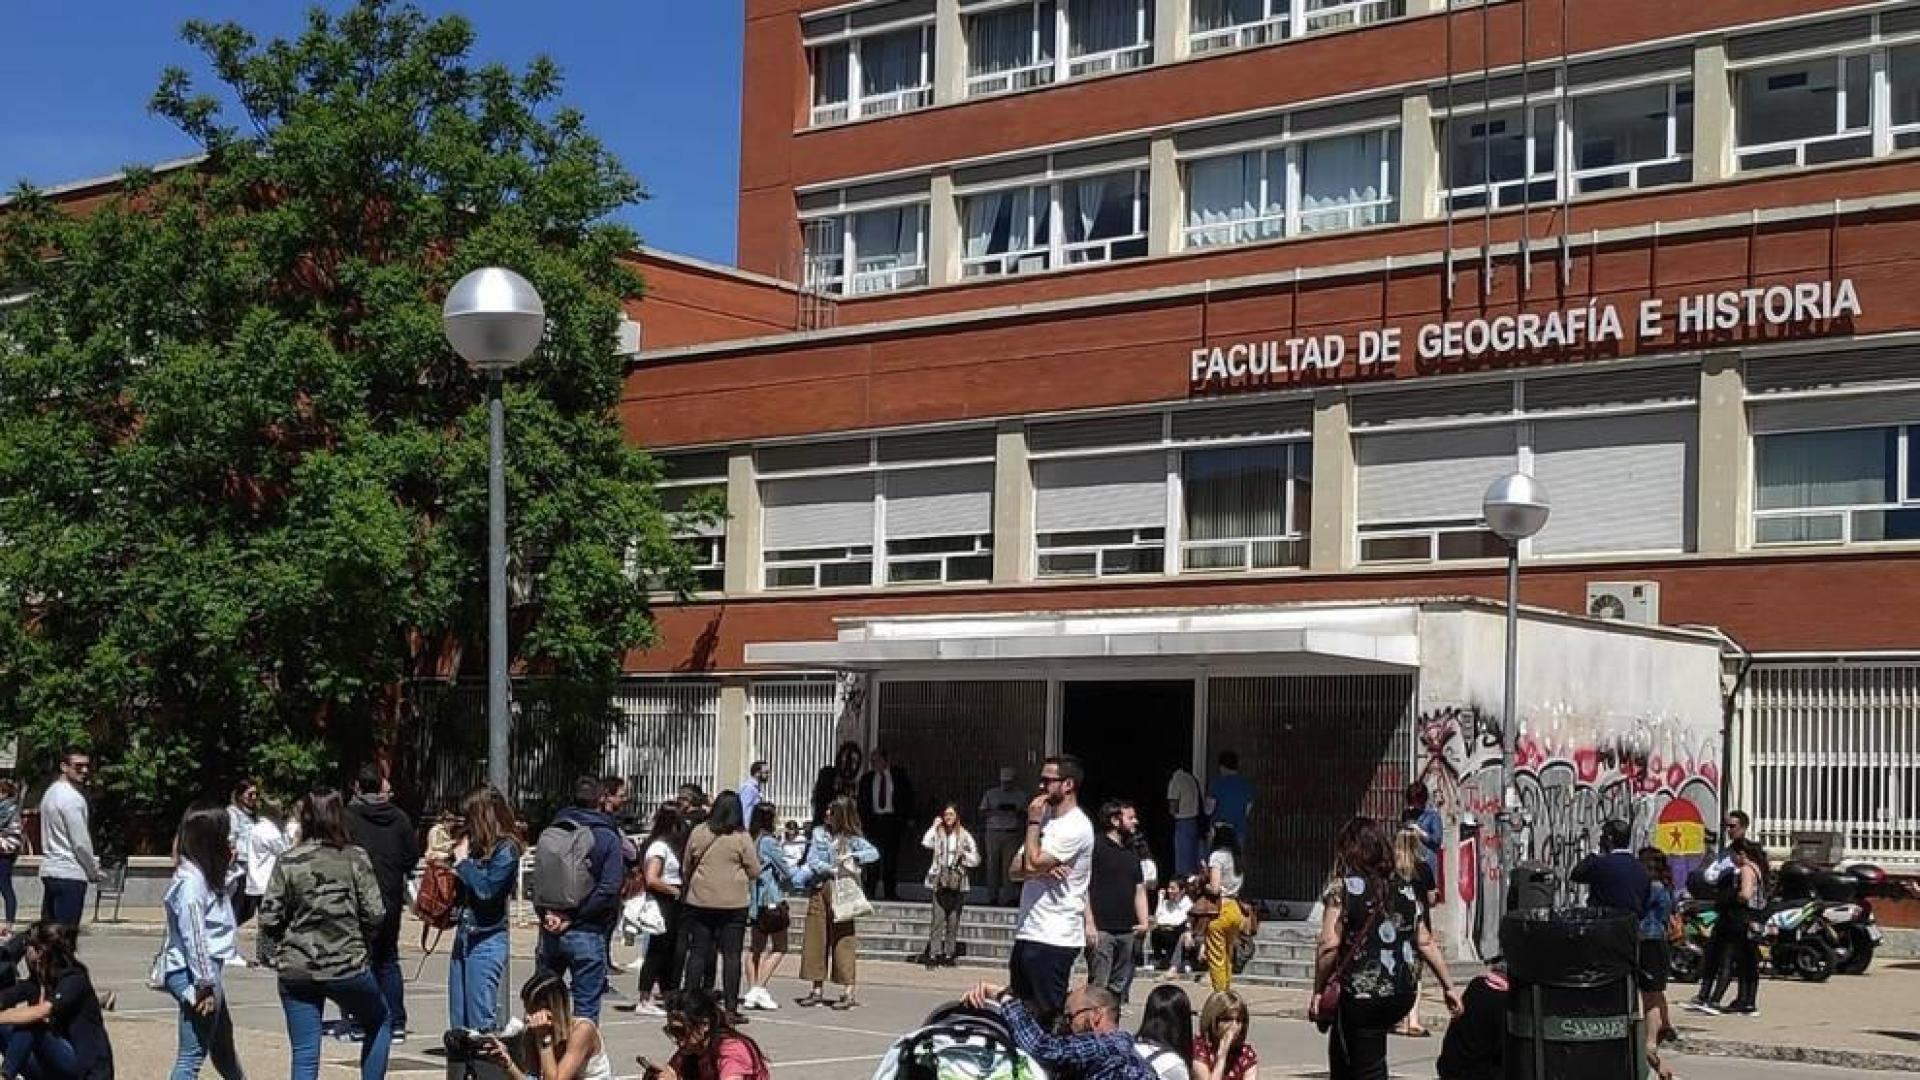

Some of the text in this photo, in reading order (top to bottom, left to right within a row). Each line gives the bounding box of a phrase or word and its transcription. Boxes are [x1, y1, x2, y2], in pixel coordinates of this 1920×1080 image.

[1191, 278, 1863, 381] FACULTAD DE GEOGRAFÍA E HISTORIA
